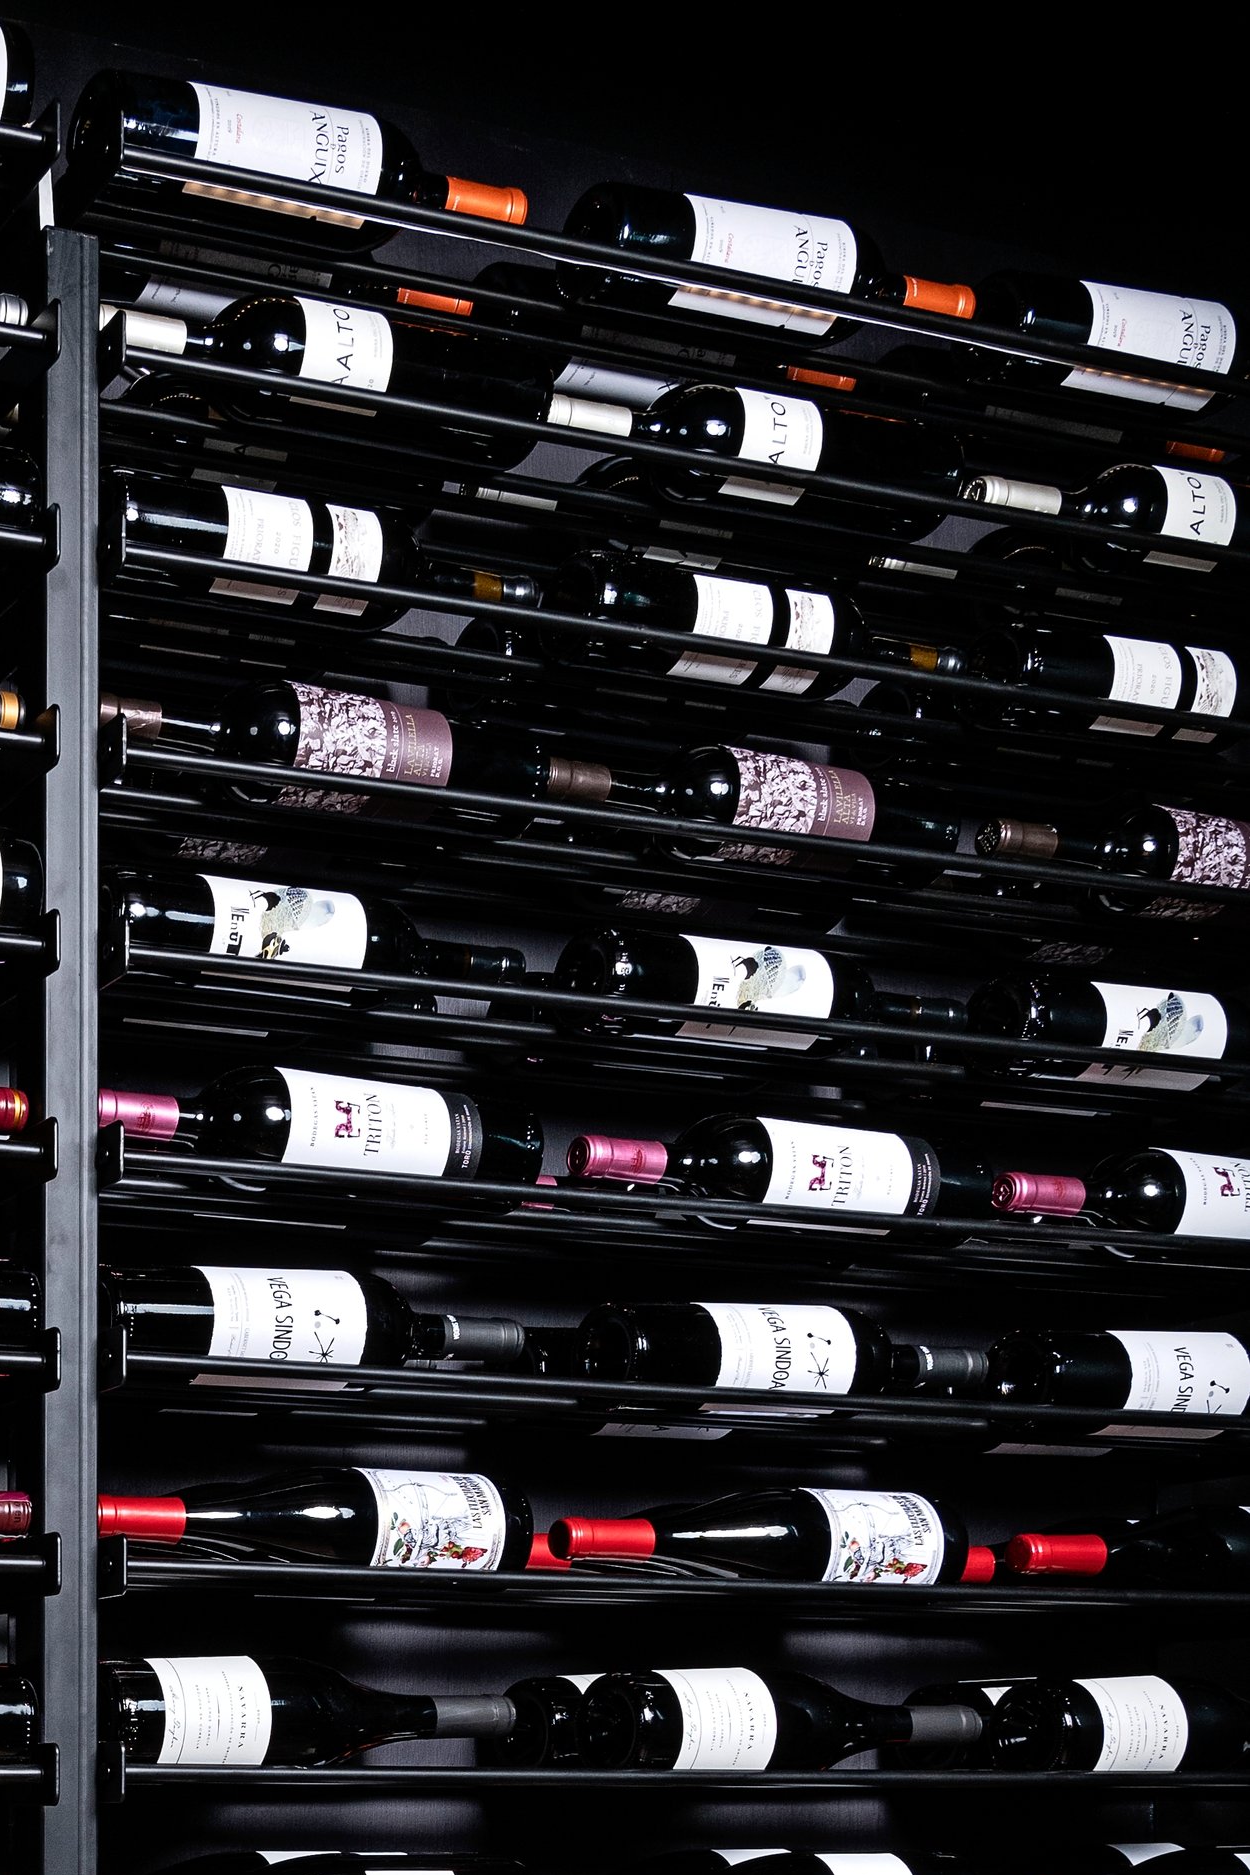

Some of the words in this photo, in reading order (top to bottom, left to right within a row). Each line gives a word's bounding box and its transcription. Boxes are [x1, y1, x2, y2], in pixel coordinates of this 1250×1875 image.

[334, 125, 350, 174] Pagos
[768, 402, 787, 464] ALTO
[1187, 476, 1206, 535] ALTO
[362, 1093, 383, 1156] TRITON
[831, 1145, 854, 1206] TRITON
[267, 1277, 292, 1309] VEGA
[757, 1307, 786, 1332] VEGA
[269, 1315, 294, 1360] SINDO
[769, 1338, 792, 1389] SINDOA
[1173, 1347, 1194, 1380] VEGA
[237, 1686, 247, 1749] NAVARRA
[744, 1692, 754, 1750] NAVARRA
